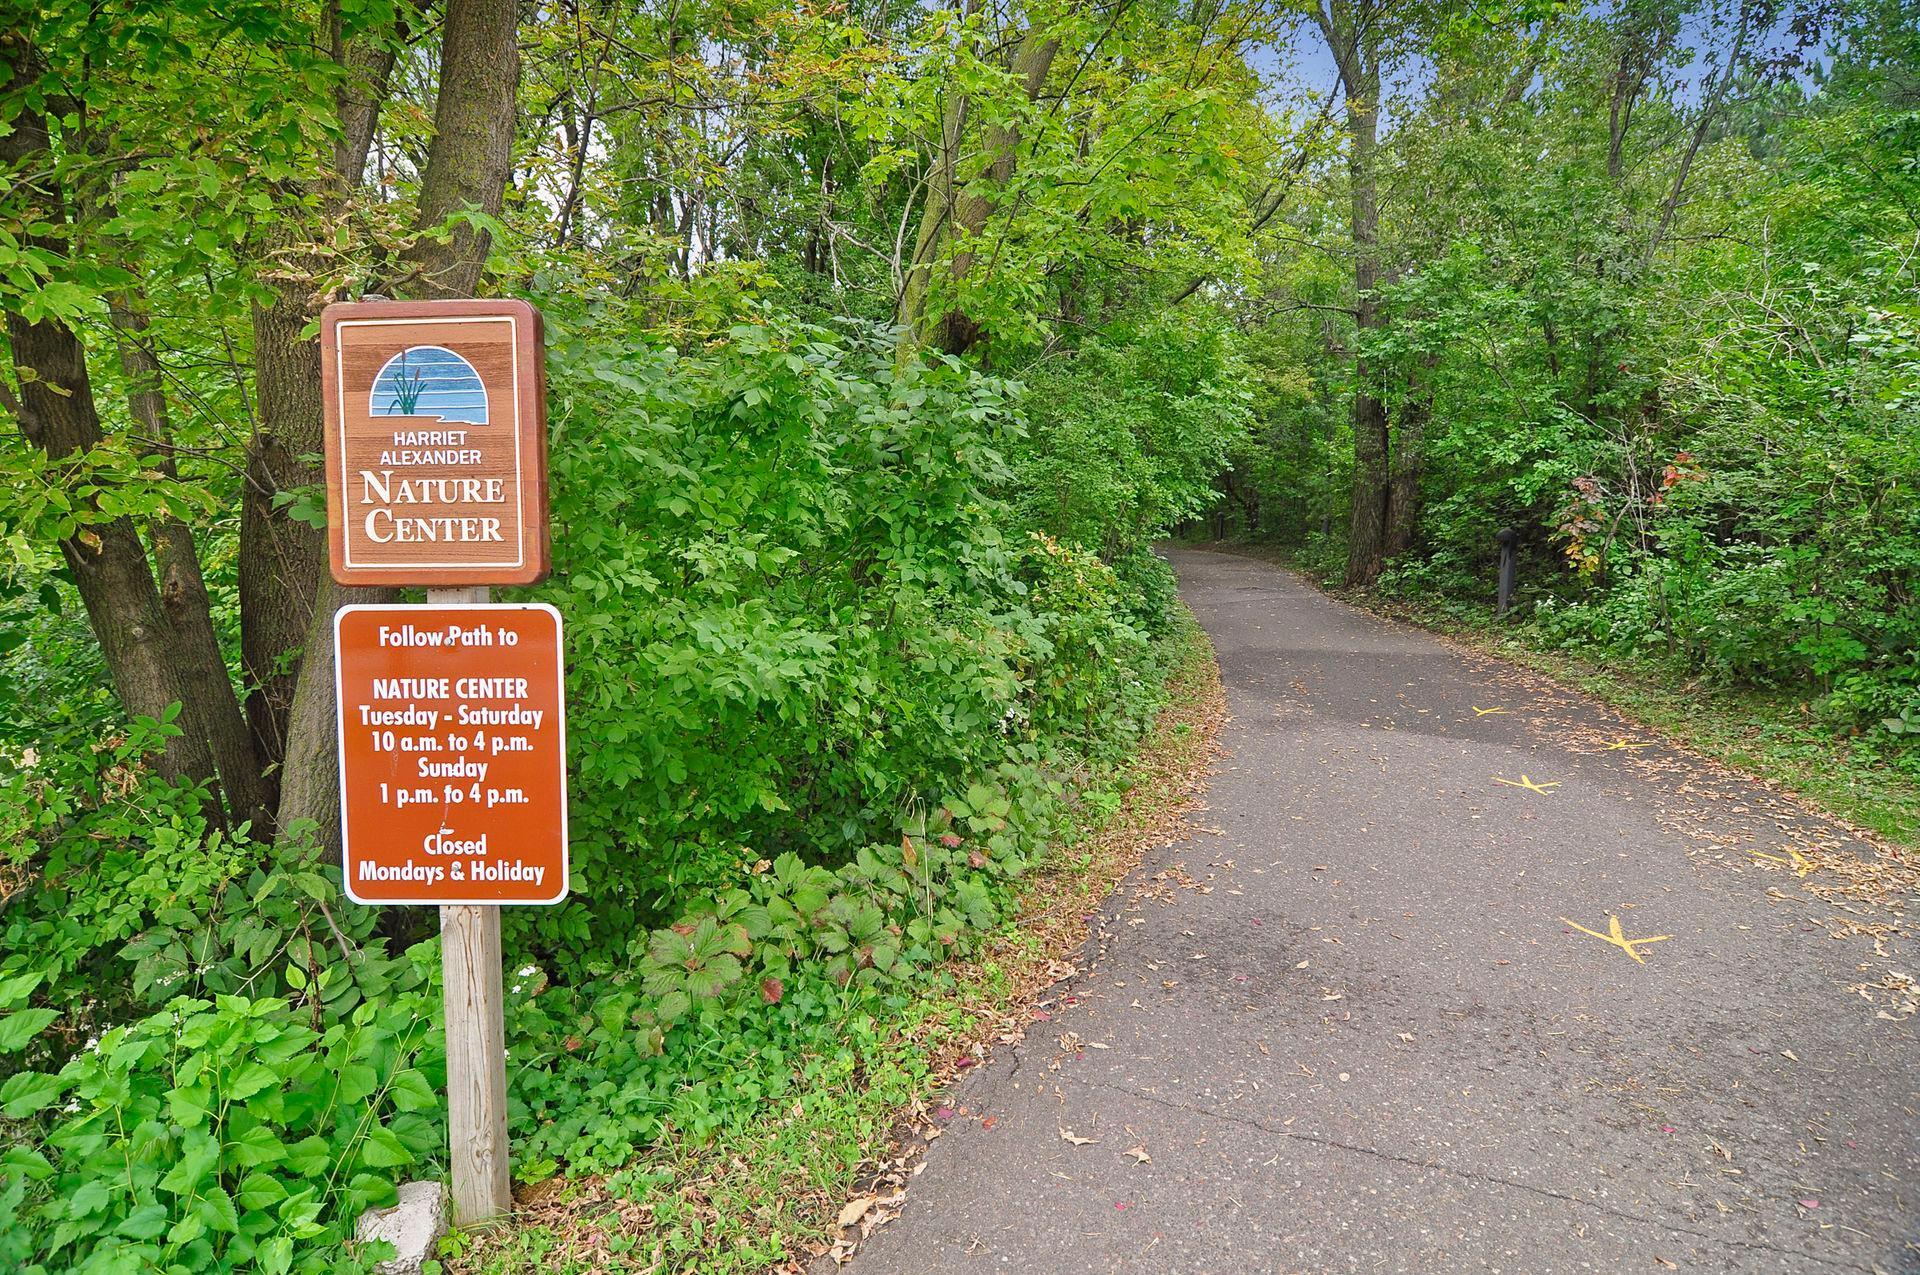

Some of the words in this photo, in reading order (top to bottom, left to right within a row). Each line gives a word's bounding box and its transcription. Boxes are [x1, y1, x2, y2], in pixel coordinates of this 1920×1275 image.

[394, 431, 467, 446] HARRIET
[380, 449, 482, 465] ALEXANDER
[379, 625, 443, 646] Follow
[449, 625, 492, 646] Path
[498, 628, 518, 646] to
[373, 678, 449, 699] NATURE
[456, 678, 528, 699] CENTER
[359, 705, 437, 729] Tuesday
[458, 704, 544, 729] Saturday
[372, 732, 394, 752] 10
[400, 736, 442, 752] a.m.
[448, 733, 466, 751] to
[474, 731, 485, 750] 4
[492, 735, 533, 756] p.m.
[418, 757, 488, 781] Sunday
[380, 784, 388, 803] 1
[397, 788, 438, 808] p.m.
[444, 784, 463, 803] to
[469, 784, 481, 802] 4
[487, 787, 529, 808] p.m.
[424, 834, 486, 856] Closed
[359, 860, 444, 883] Mondays
[450, 862, 465, 881] &
[471, 860, 545, 886] Holiday
